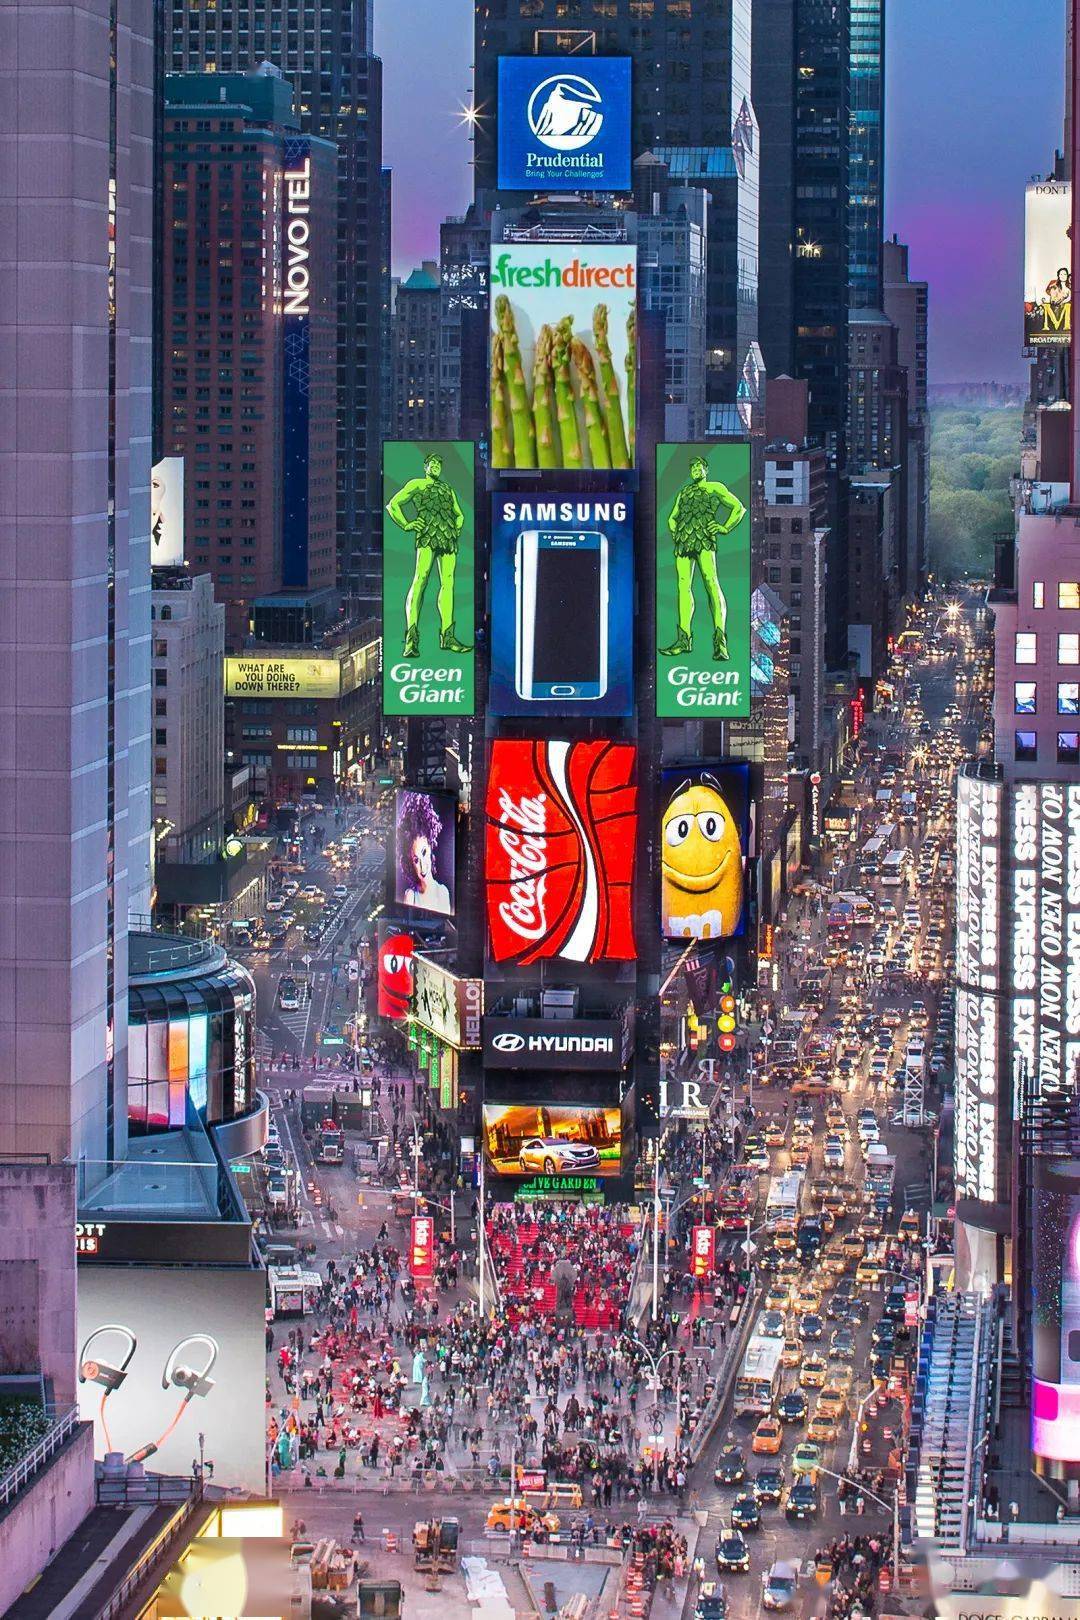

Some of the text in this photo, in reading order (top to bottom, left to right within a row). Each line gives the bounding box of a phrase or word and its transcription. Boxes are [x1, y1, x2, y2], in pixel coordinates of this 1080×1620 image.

[526, 153, 603, 167] Prudential
[526, 170, 545, 178] Bring
[564, 170, 604, 179] Challenges
[1035, 186, 1068, 195] DON'T
[284, 158, 310, 314] NOVOTEL
[491, 254, 635, 288] freshdirect
[503, 503, 626, 522] SAMSUNG
[238, 664, 285, 673] WHAT ARE
[245, 673, 295, 682] YOU DOING
[390, 664, 462, 683] Green
[668, 667, 740, 685] Green
[235, 682, 301, 692] DOWN THERE?
[399, 682, 461, 703] Giant
[676, 684, 738, 706] Giant
[1040, 821, 1061, 885] NOW
[498, 787, 548, 940] Coca-Cola
[982, 847, 997, 966] EXPRESS
[1014, 870, 1036, 990] EXPRESS
[1040, 886, 1061, 956] OPEN
[1040, 958, 1061, 1021] NOW
[529, 1037, 613, 1052] HYUNDAI
[681, 1082, 709, 1108] R
[552, 1178, 597, 1189] GARDEN
[76, 1238, 96, 1251] IS
